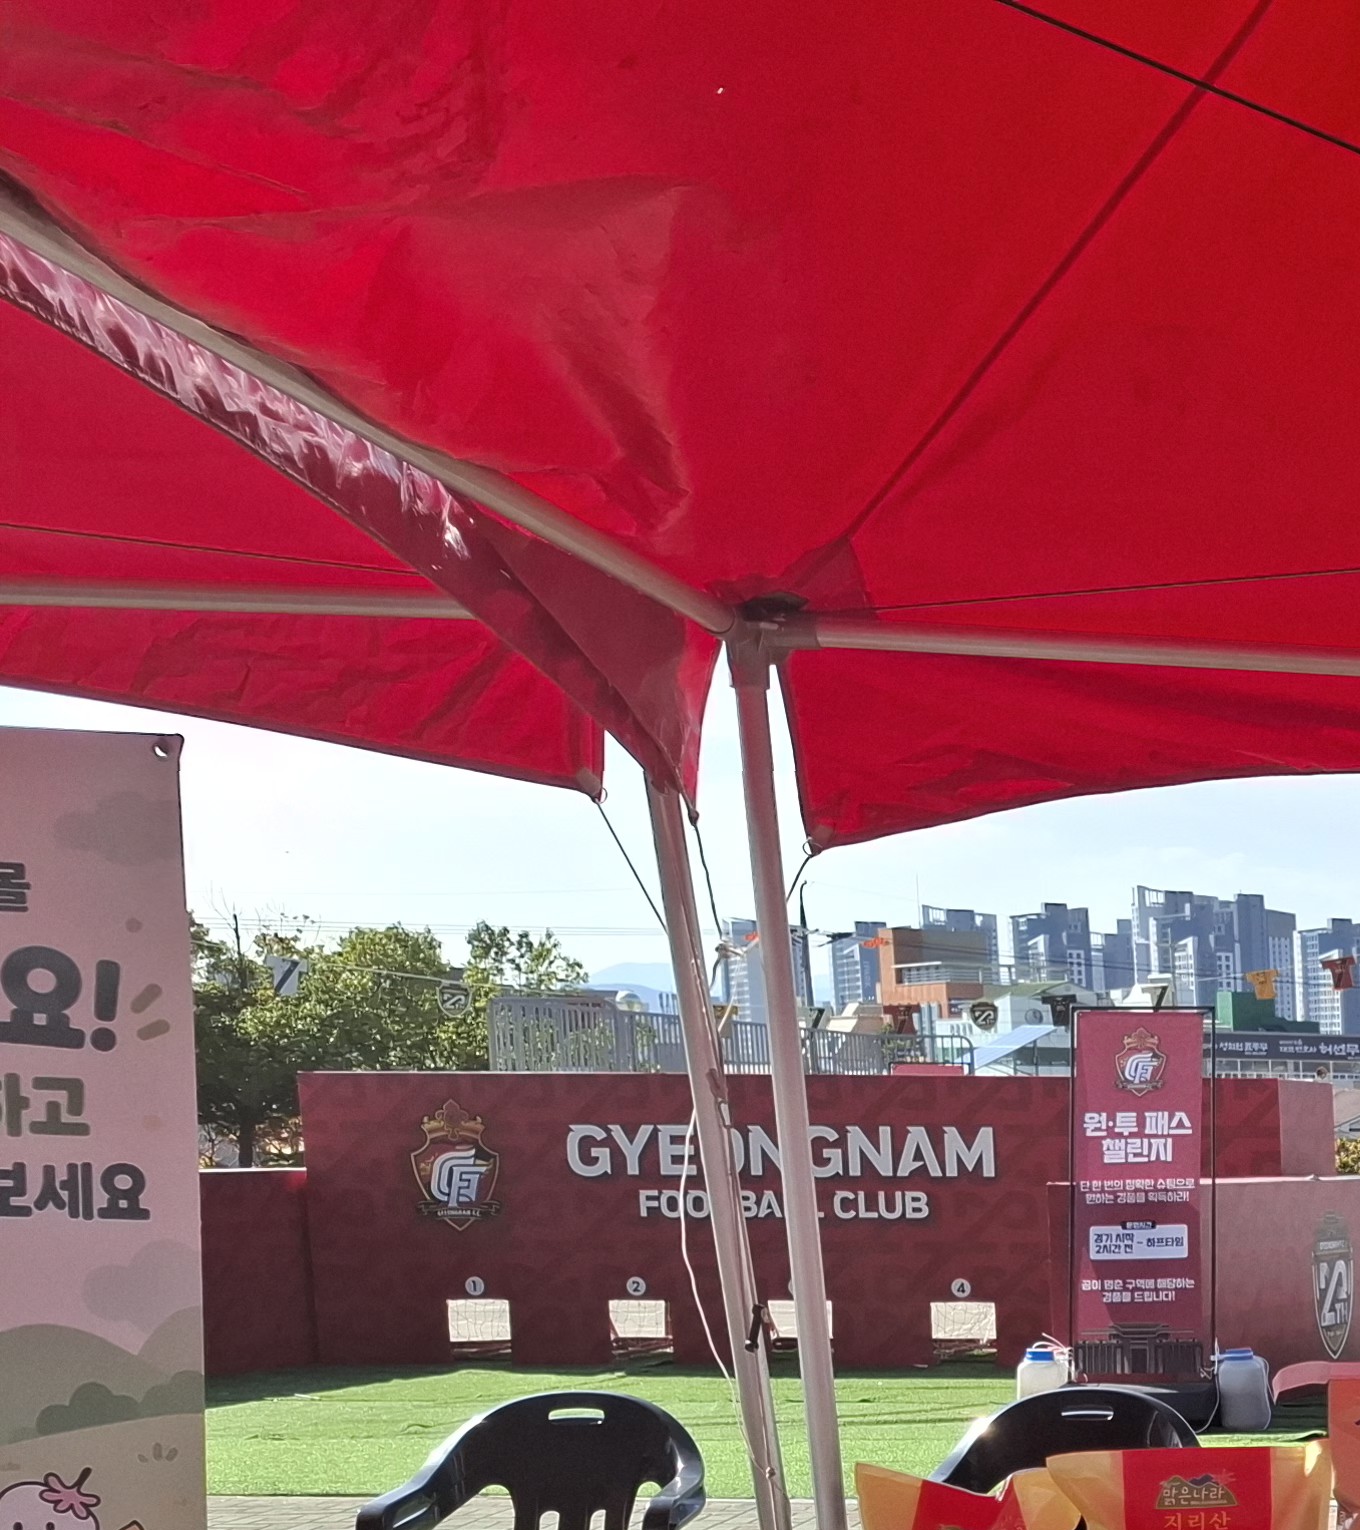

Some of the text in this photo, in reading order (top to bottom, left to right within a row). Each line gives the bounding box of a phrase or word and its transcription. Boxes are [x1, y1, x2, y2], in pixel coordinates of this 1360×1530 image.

[1144, 1111, 1193, 1136] 패스
[566, 1124, 996, 1178] GYENGNAM
[1102, 1137, 1173, 1164] 챌린지
[833, 1189, 930, 1220] CLUB
[1094, 1233, 1135, 1244] 경기 시작
[1095, 1244, 1122, 1255] 2시간
[1146, 1236, 1185, 1248] 하프타임
[1134, 1290, 1176, 1302] 드립니다!
[1161, 1484, 1227, 1508] 맑은나라
